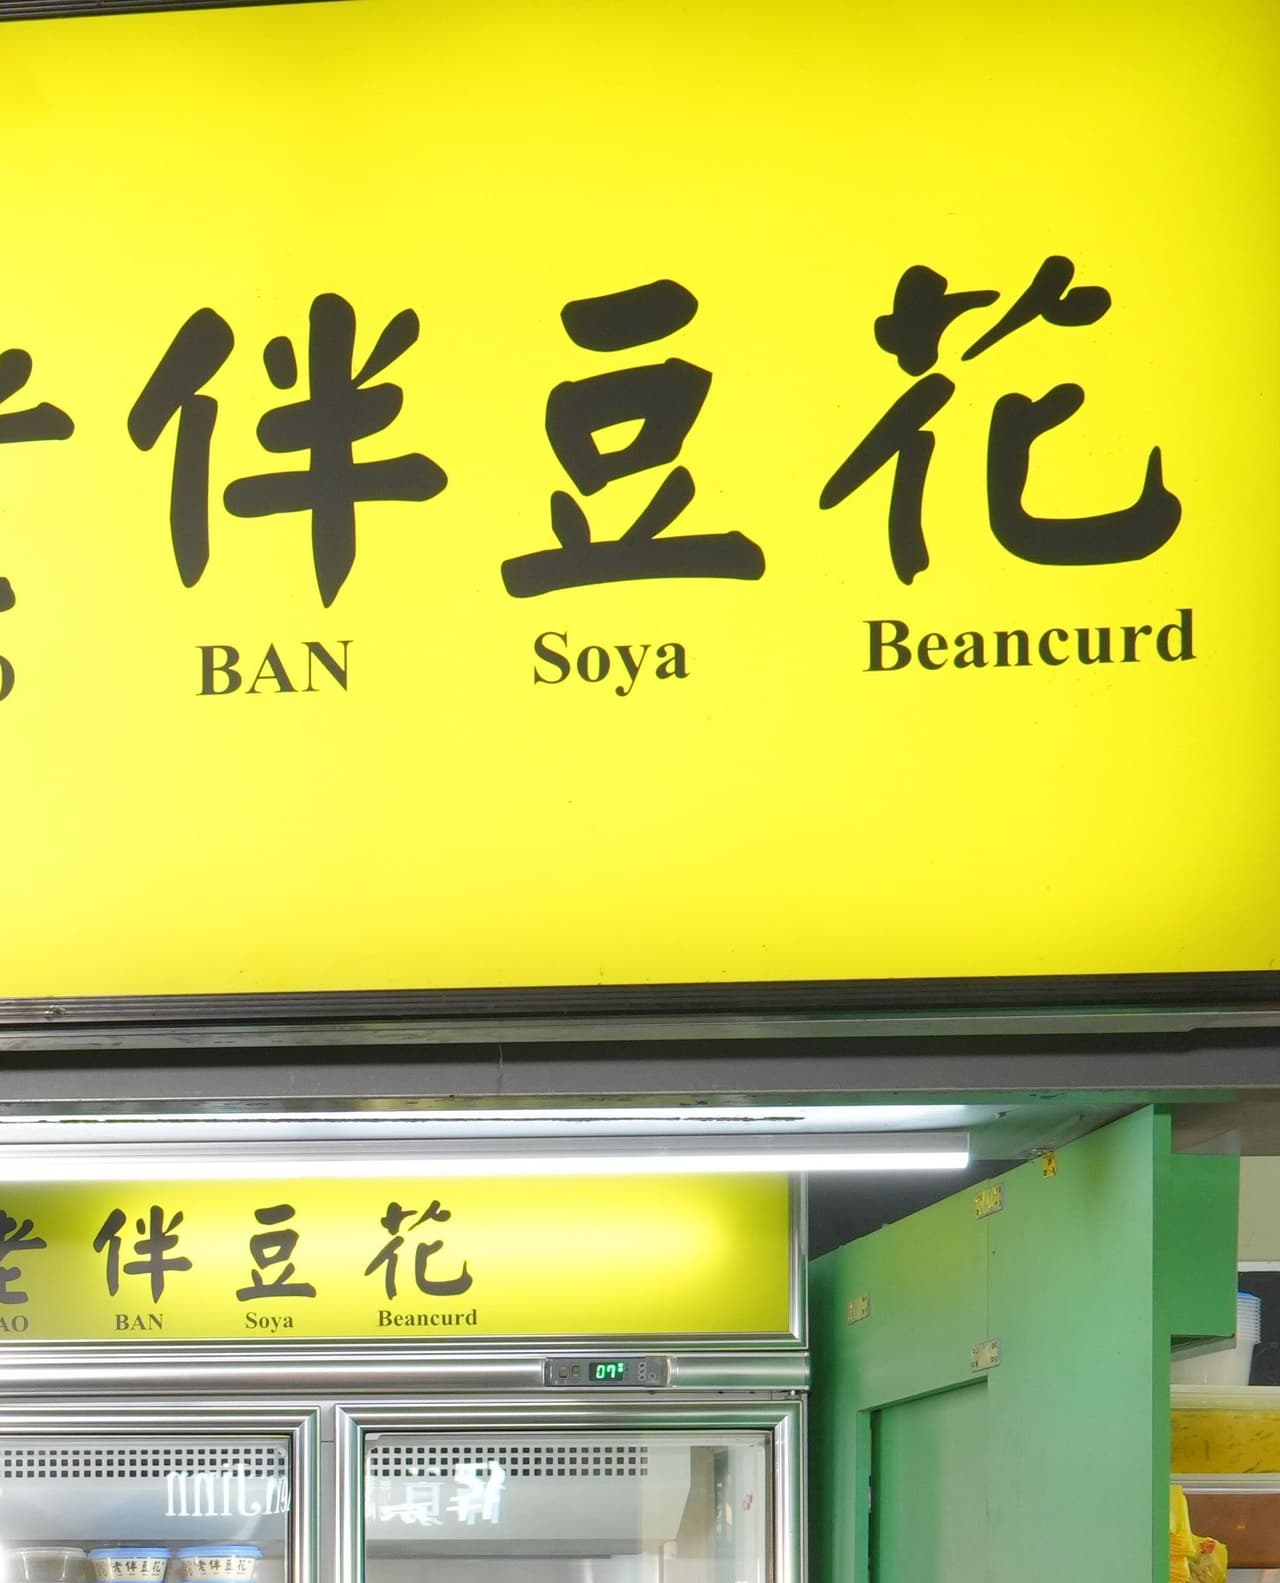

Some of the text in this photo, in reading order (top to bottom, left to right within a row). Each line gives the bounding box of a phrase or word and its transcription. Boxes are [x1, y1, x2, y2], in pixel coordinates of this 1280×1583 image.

[199, 641, 352, 695] BAN
[534, 632, 689, 696] Soya
[867, 609, 1196, 671] Beancurd
[116, 1314, 162, 1330] BAN
[246, 1313, 293, 1333] Soya
[379, 1309, 477, 1326] Beancurd
